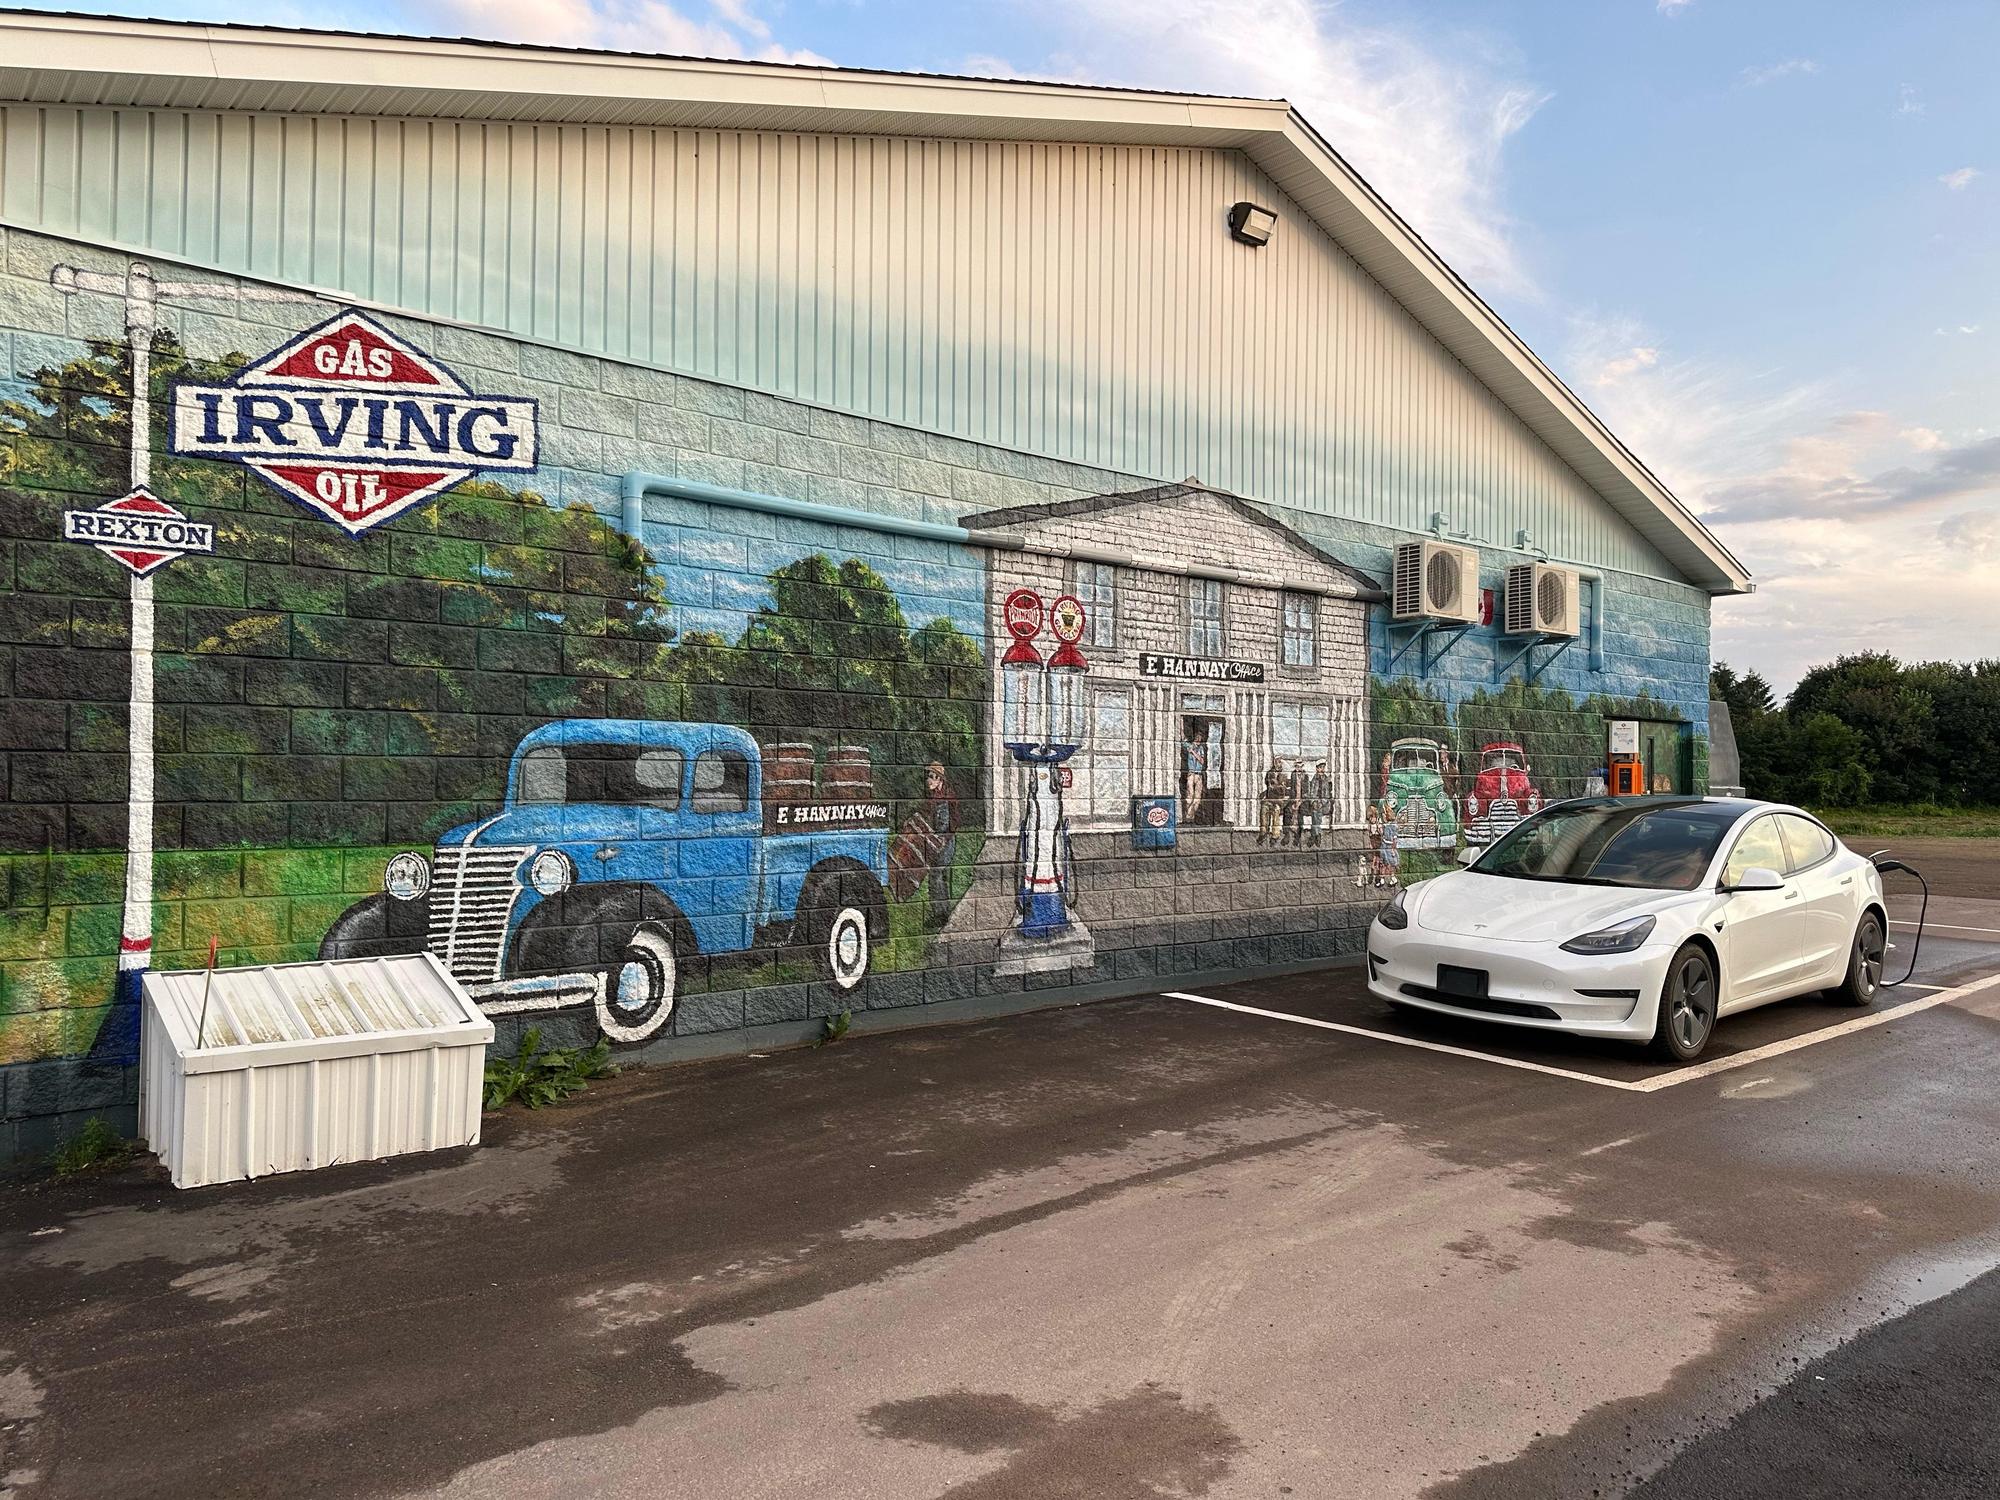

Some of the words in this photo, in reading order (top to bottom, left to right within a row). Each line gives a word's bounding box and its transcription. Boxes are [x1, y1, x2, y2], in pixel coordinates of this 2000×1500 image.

[314, 339, 393, 378] GAS
[195, 393, 519, 460] IRVING
[315, 471, 387, 513] OIL
[71, 514, 209, 546] REXTON
[1146, 656, 1158, 674] E
[1161, 657, 1229, 679] HANNAY
[1229, 662, 1262, 679] Office
[777, 807, 789, 824] E
[793, 804, 867, 823] HANNAY
